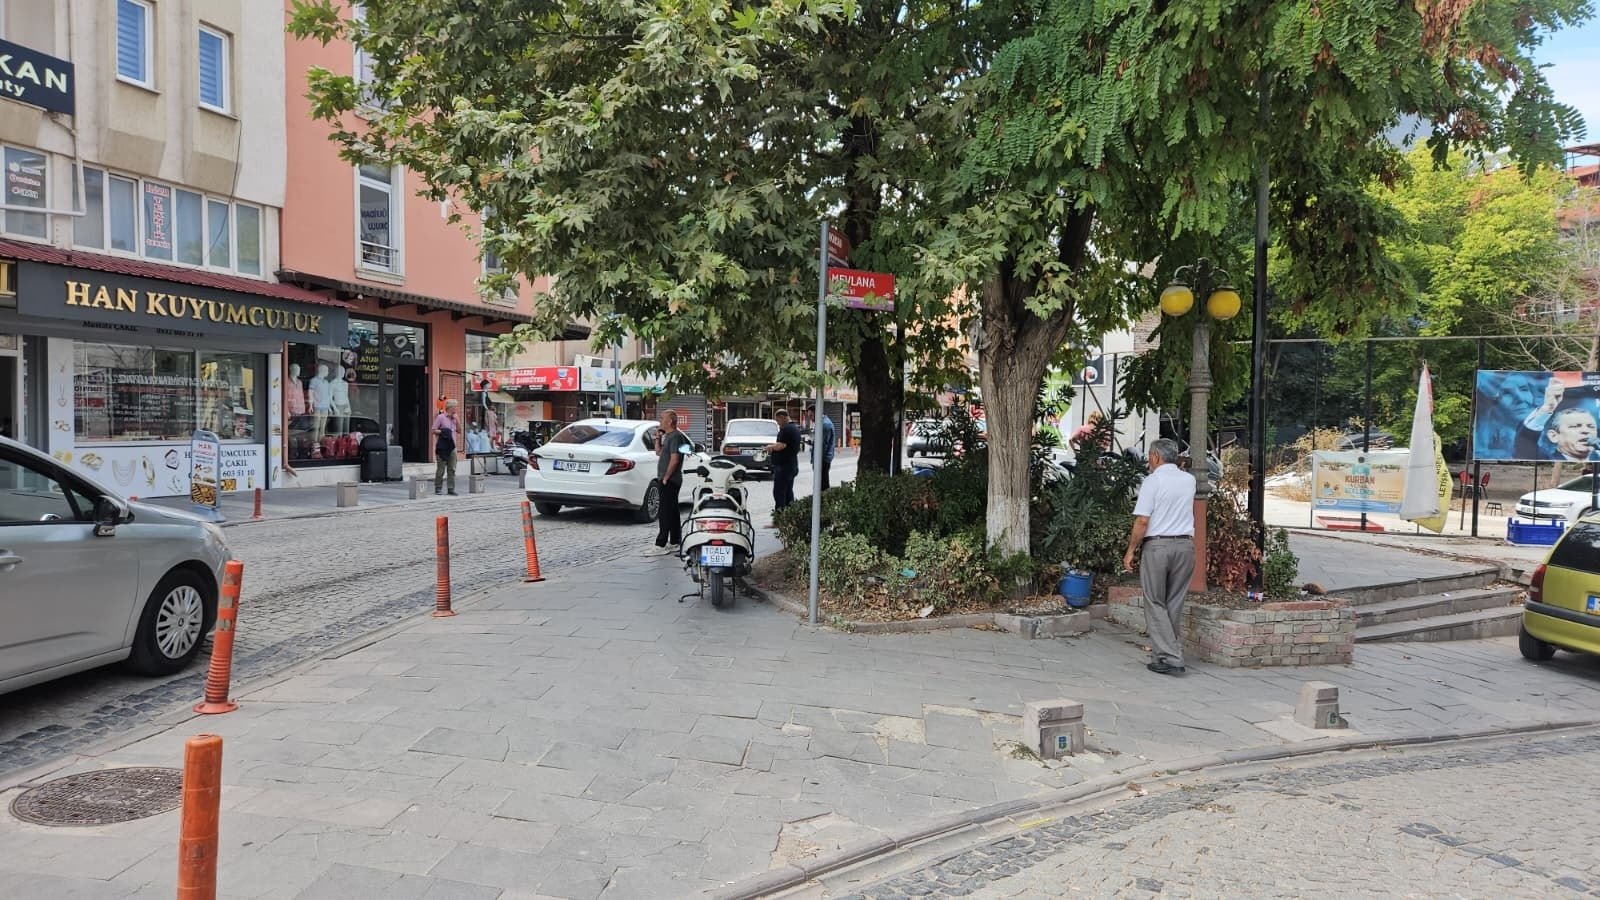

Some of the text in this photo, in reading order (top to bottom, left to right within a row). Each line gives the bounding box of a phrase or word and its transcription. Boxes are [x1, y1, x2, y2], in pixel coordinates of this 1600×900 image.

[831, 273, 876, 288] MEVLANA
[65, 280, 322, 333] HAN KUYUMCULUK
[221, 450, 258, 458] UMCULUK
[1344, 475, 1375, 484] KURBAN
